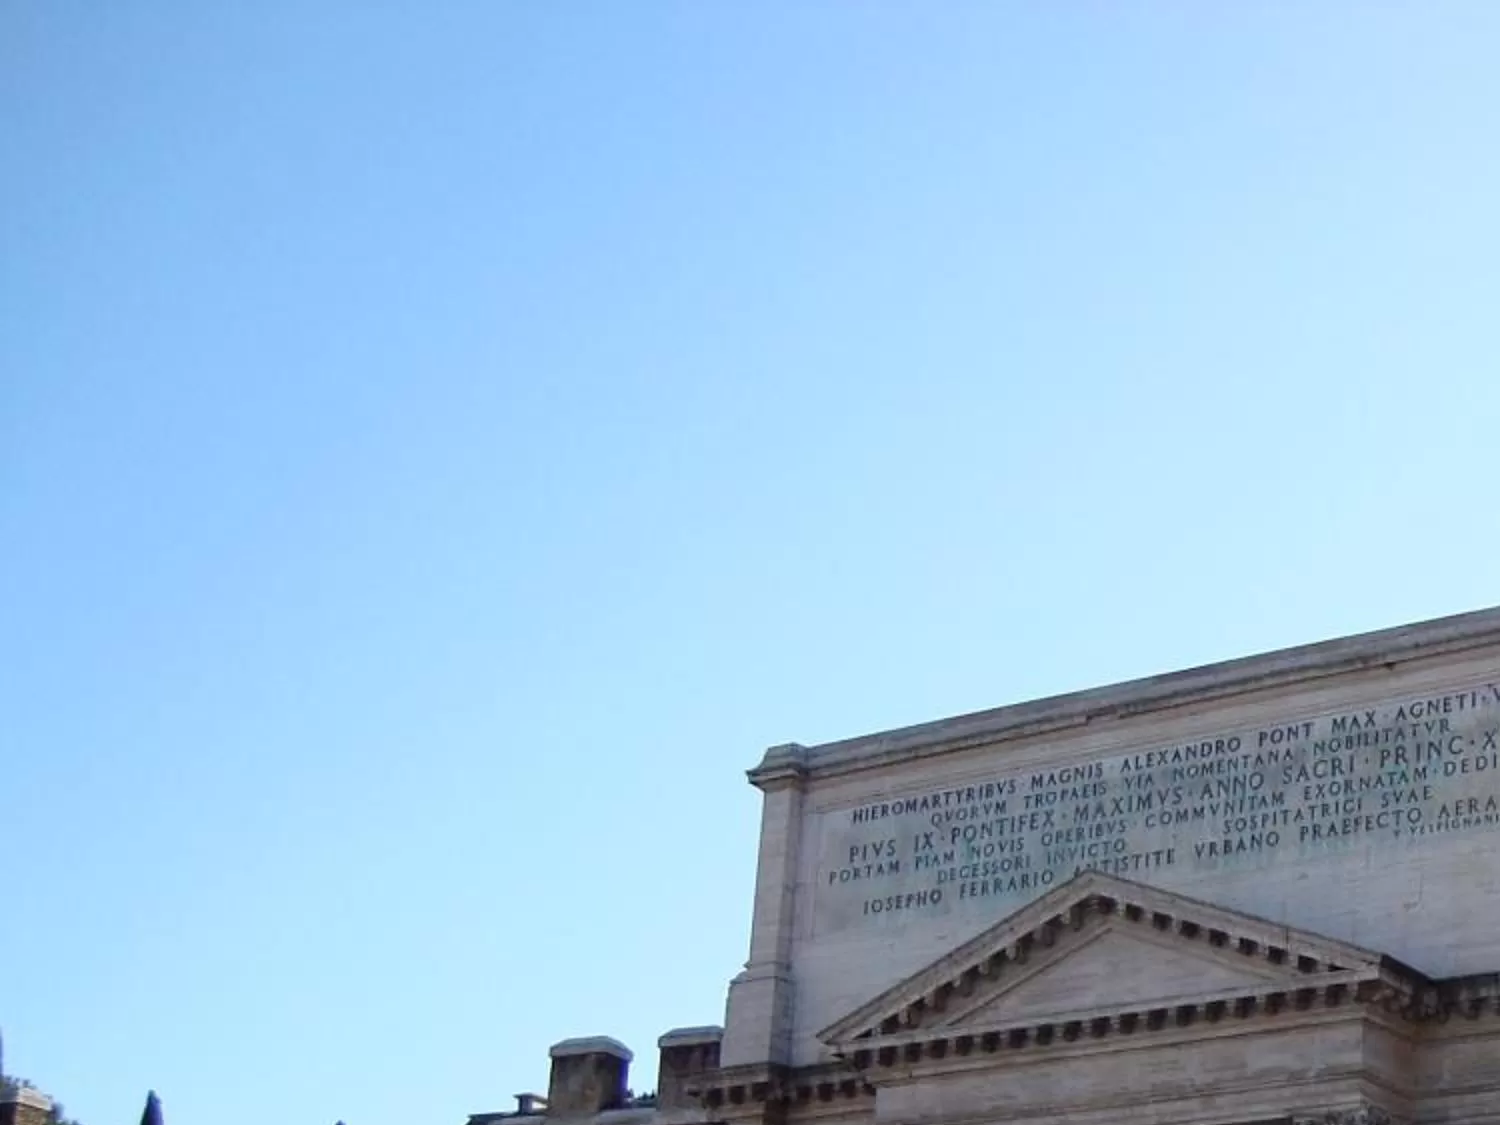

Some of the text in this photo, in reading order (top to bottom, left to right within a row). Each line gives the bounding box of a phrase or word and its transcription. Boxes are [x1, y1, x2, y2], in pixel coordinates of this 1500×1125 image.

[931, 800, 1007, 827] QVORVM
[1124, 773, 1154, 790] VIA
[1172, 748, 1293, 780] NOMENTANA
[1031, 762, 1103, 791] MAGNIS
[1121, 737, 1241, 772] ALEXANDRO
[1258, 722, 1316, 747] PONT
[1303, 765, 1428, 801] EXORNATAM
[849, 839, 897, 863] PIVS
[914, 831, 933, 853] IX
[951, 810, 1054, 845] PONTIFEX
[1074, 786, 1183, 824] MAXIMVS
[1200, 771, 1265, 801] ANNO
[1282, 755, 1354, 785] SACRI
[1380, 735, 1464, 769] PRINC
[1194, 831, 1280, 860] VRBANO
[1299, 808, 1421, 843] PRAEFECTO
